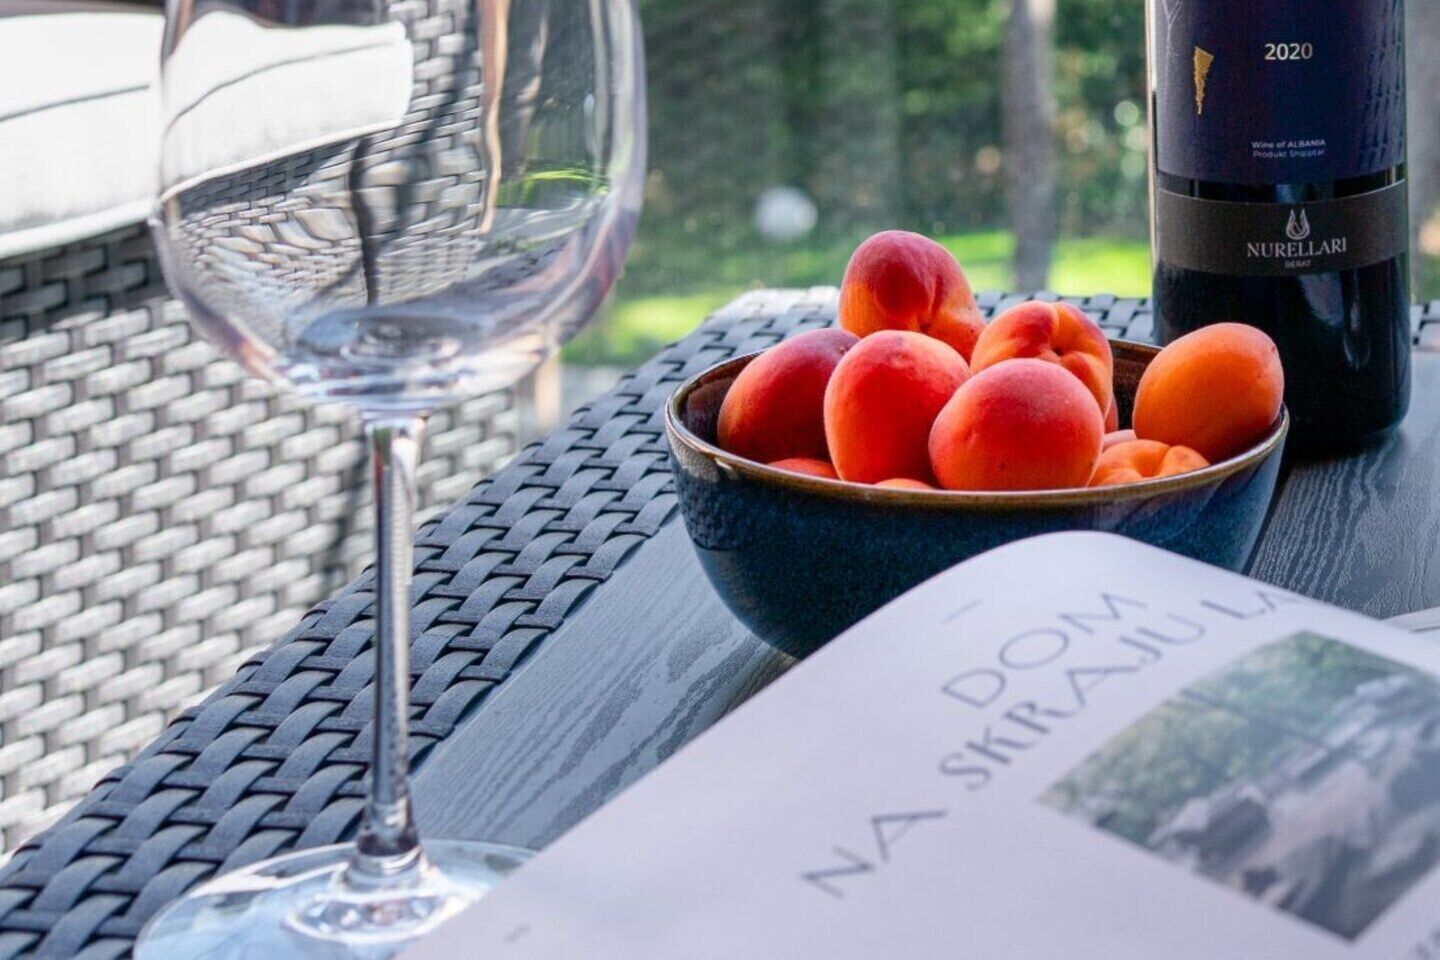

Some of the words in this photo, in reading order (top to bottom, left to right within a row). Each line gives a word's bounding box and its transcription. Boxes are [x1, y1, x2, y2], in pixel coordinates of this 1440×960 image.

[1264, 42, 1313, 61] 2020
[1251, 140, 1274, 149] Wine
[1276, 140, 1285, 148] of
[1287, 138, 1326, 148] ALBANIA
[1246, 236, 1347, 258] NURELLARI
[941, 590, 1148, 709] DOM
[800, 809, 949, 898] NA
[938, 612, 1206, 792] SKRAJU
